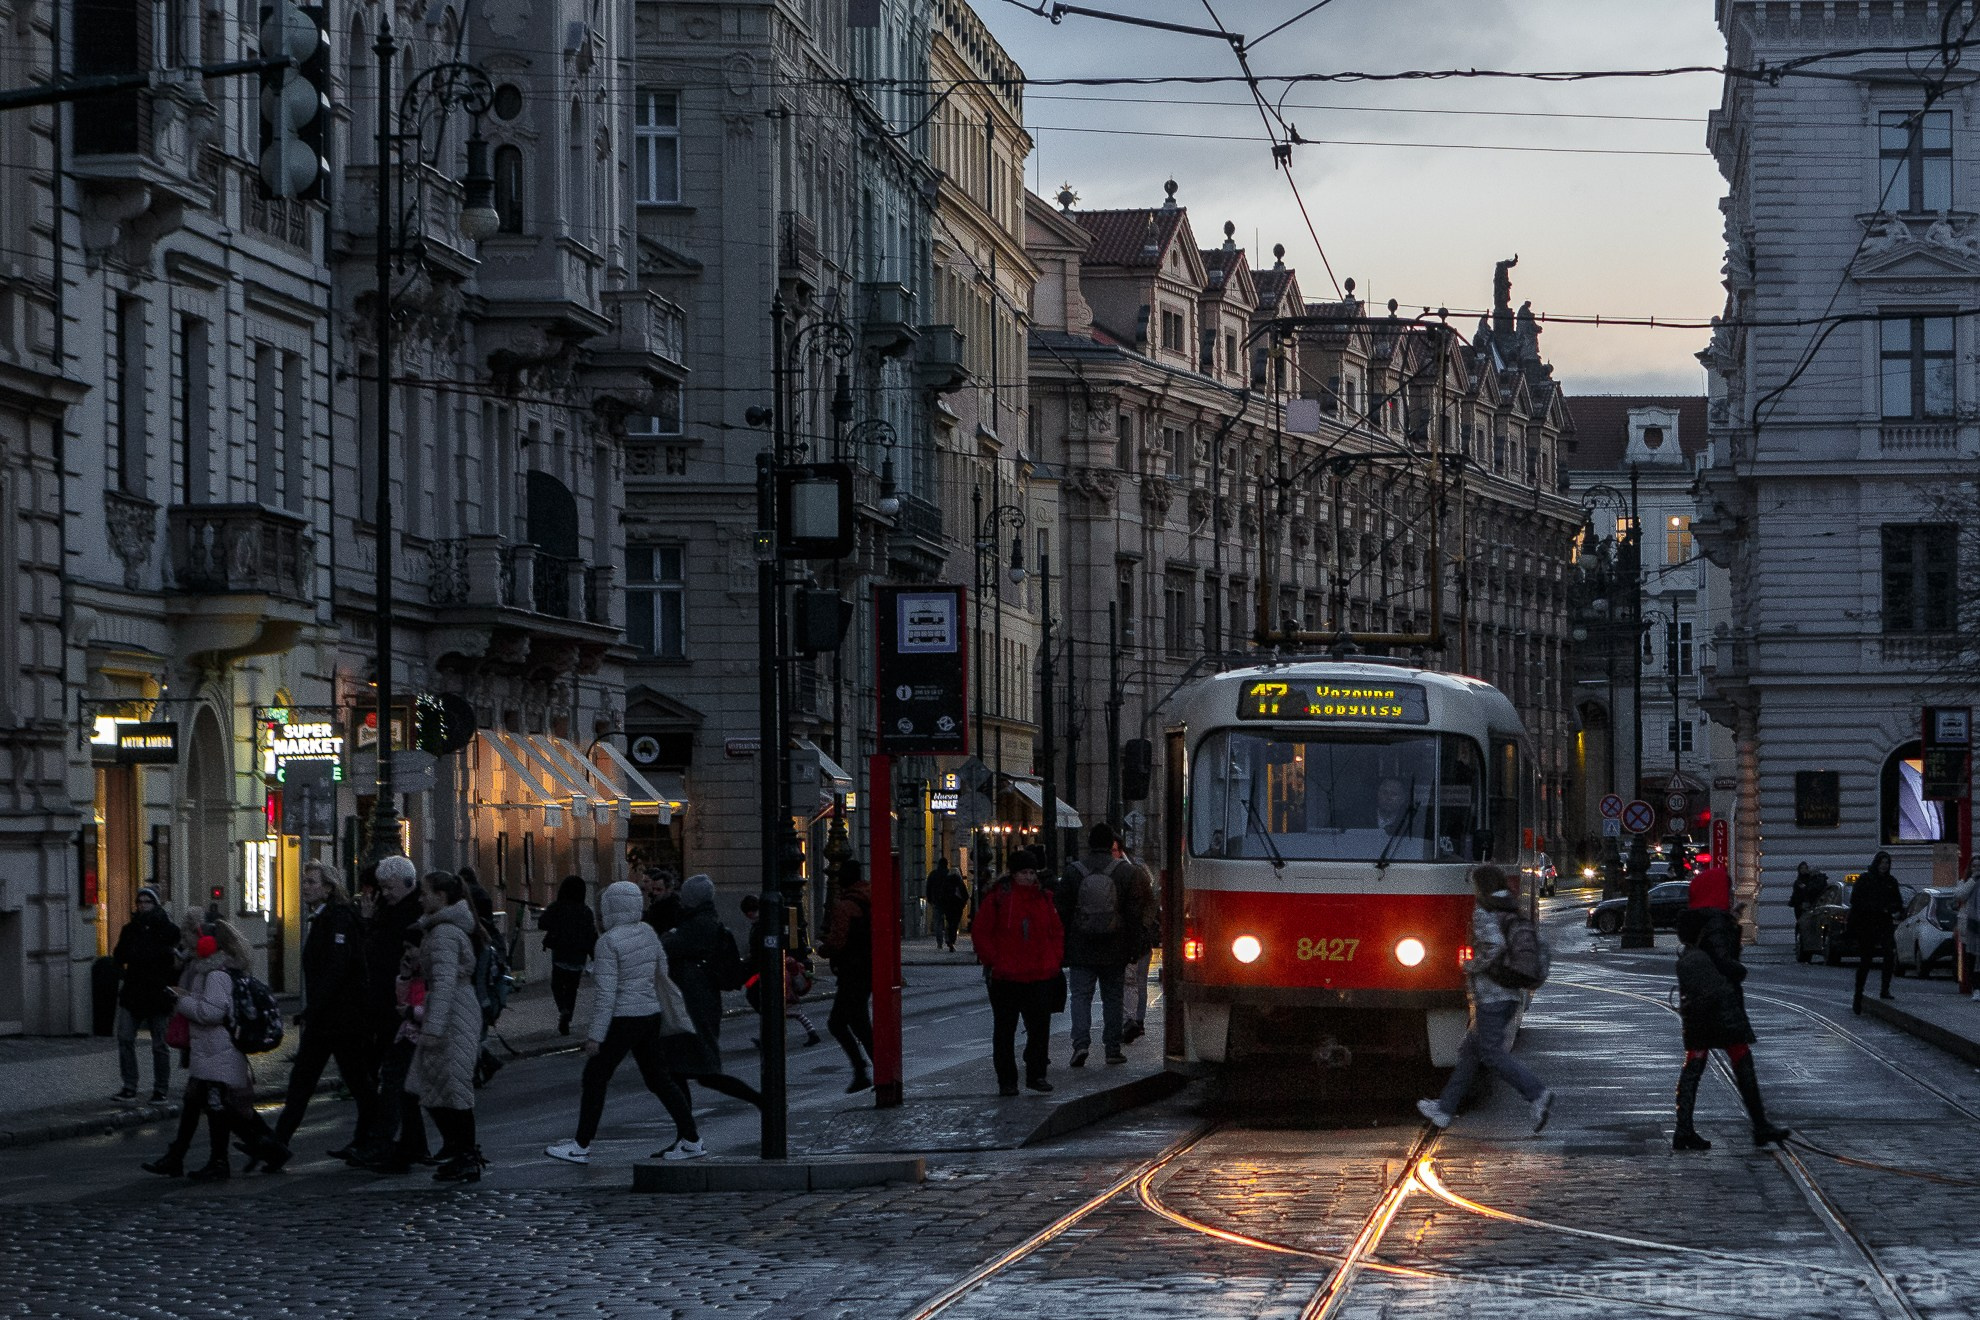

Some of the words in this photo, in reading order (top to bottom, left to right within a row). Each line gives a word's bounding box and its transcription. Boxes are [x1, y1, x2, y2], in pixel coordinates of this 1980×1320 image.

[1250, 683, 1288, 714] 17
[283, 723, 333, 739] SUPER
[274, 736, 344, 755] MARKET
[931, 800, 959, 810] MARKE
[1297, 937, 1361, 961] 8427
